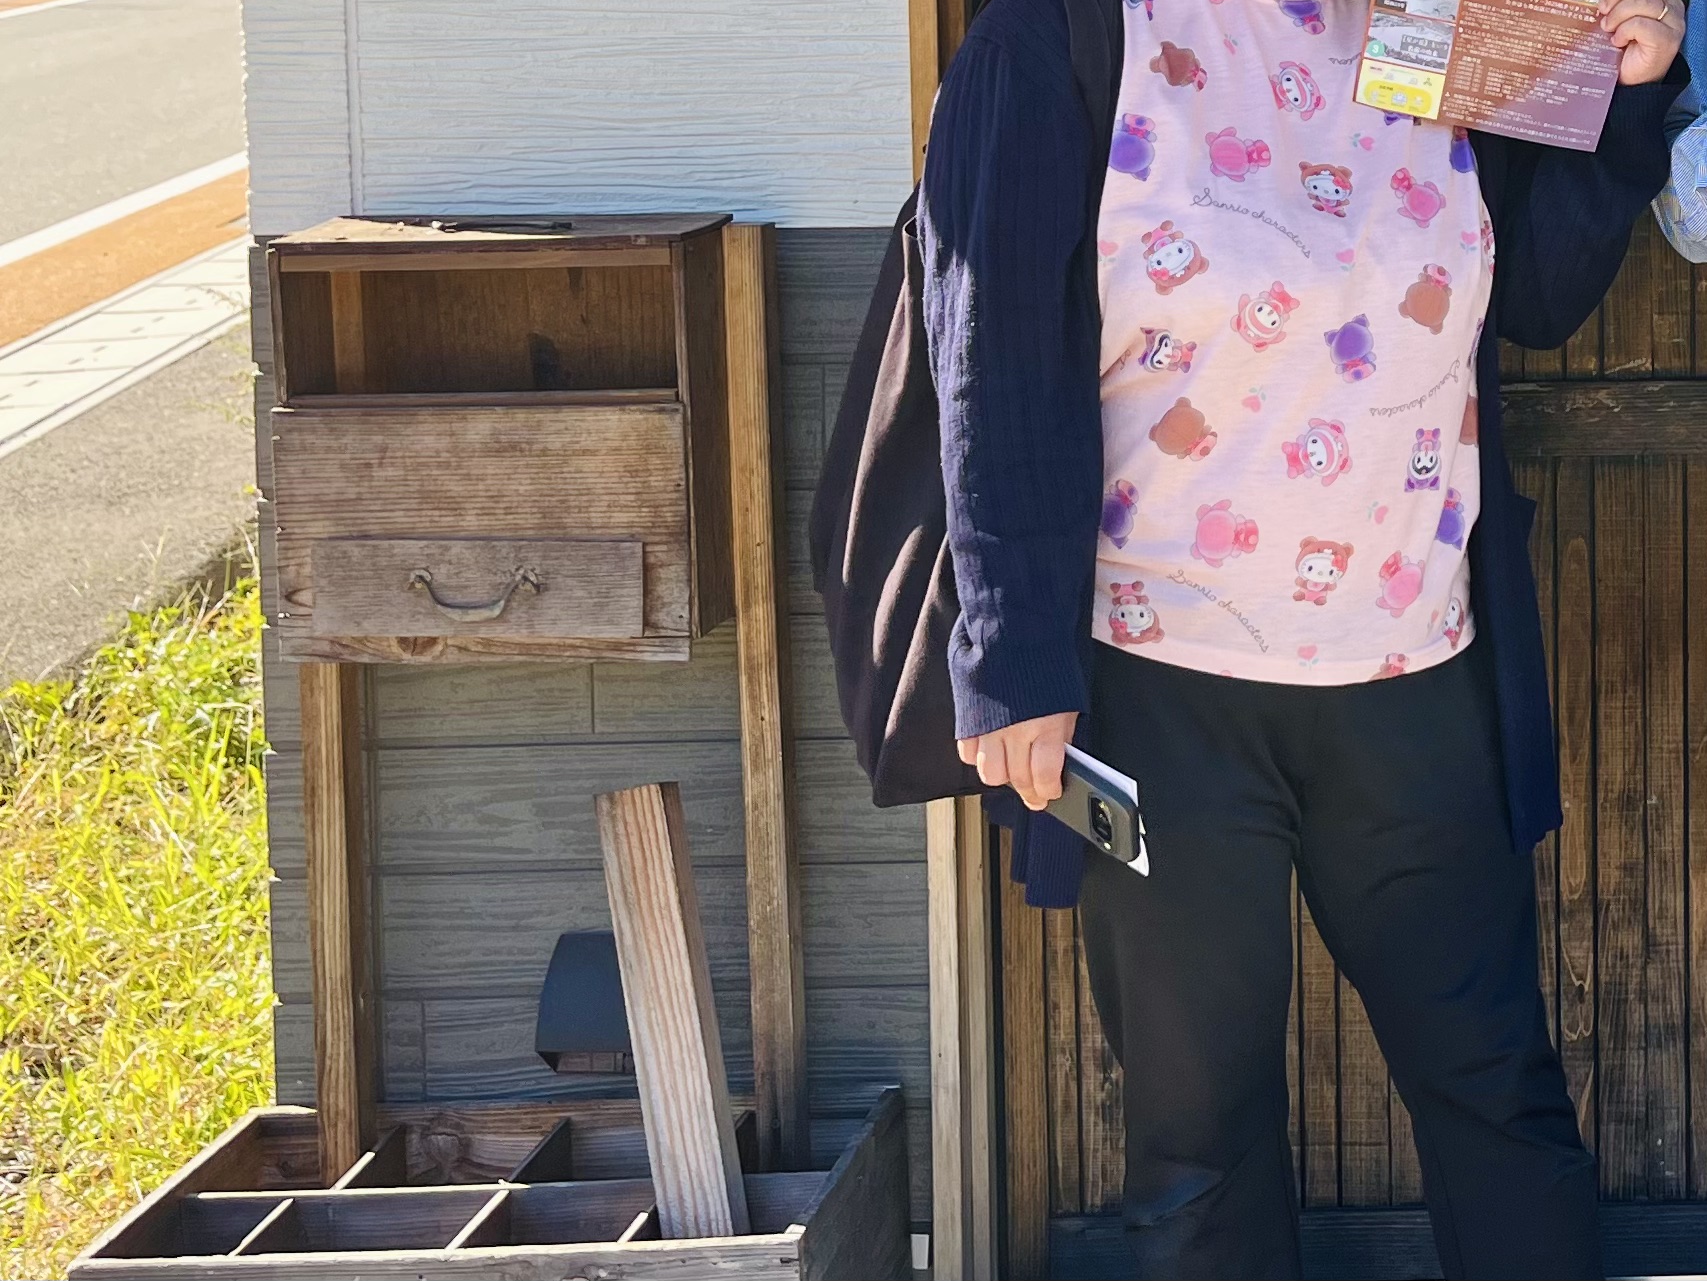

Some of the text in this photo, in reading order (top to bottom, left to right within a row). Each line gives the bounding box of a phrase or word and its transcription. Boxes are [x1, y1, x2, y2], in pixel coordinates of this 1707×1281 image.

[1371, 44, 1379, 53] 3
[1190, 187, 1311, 259] Sanrio characters
